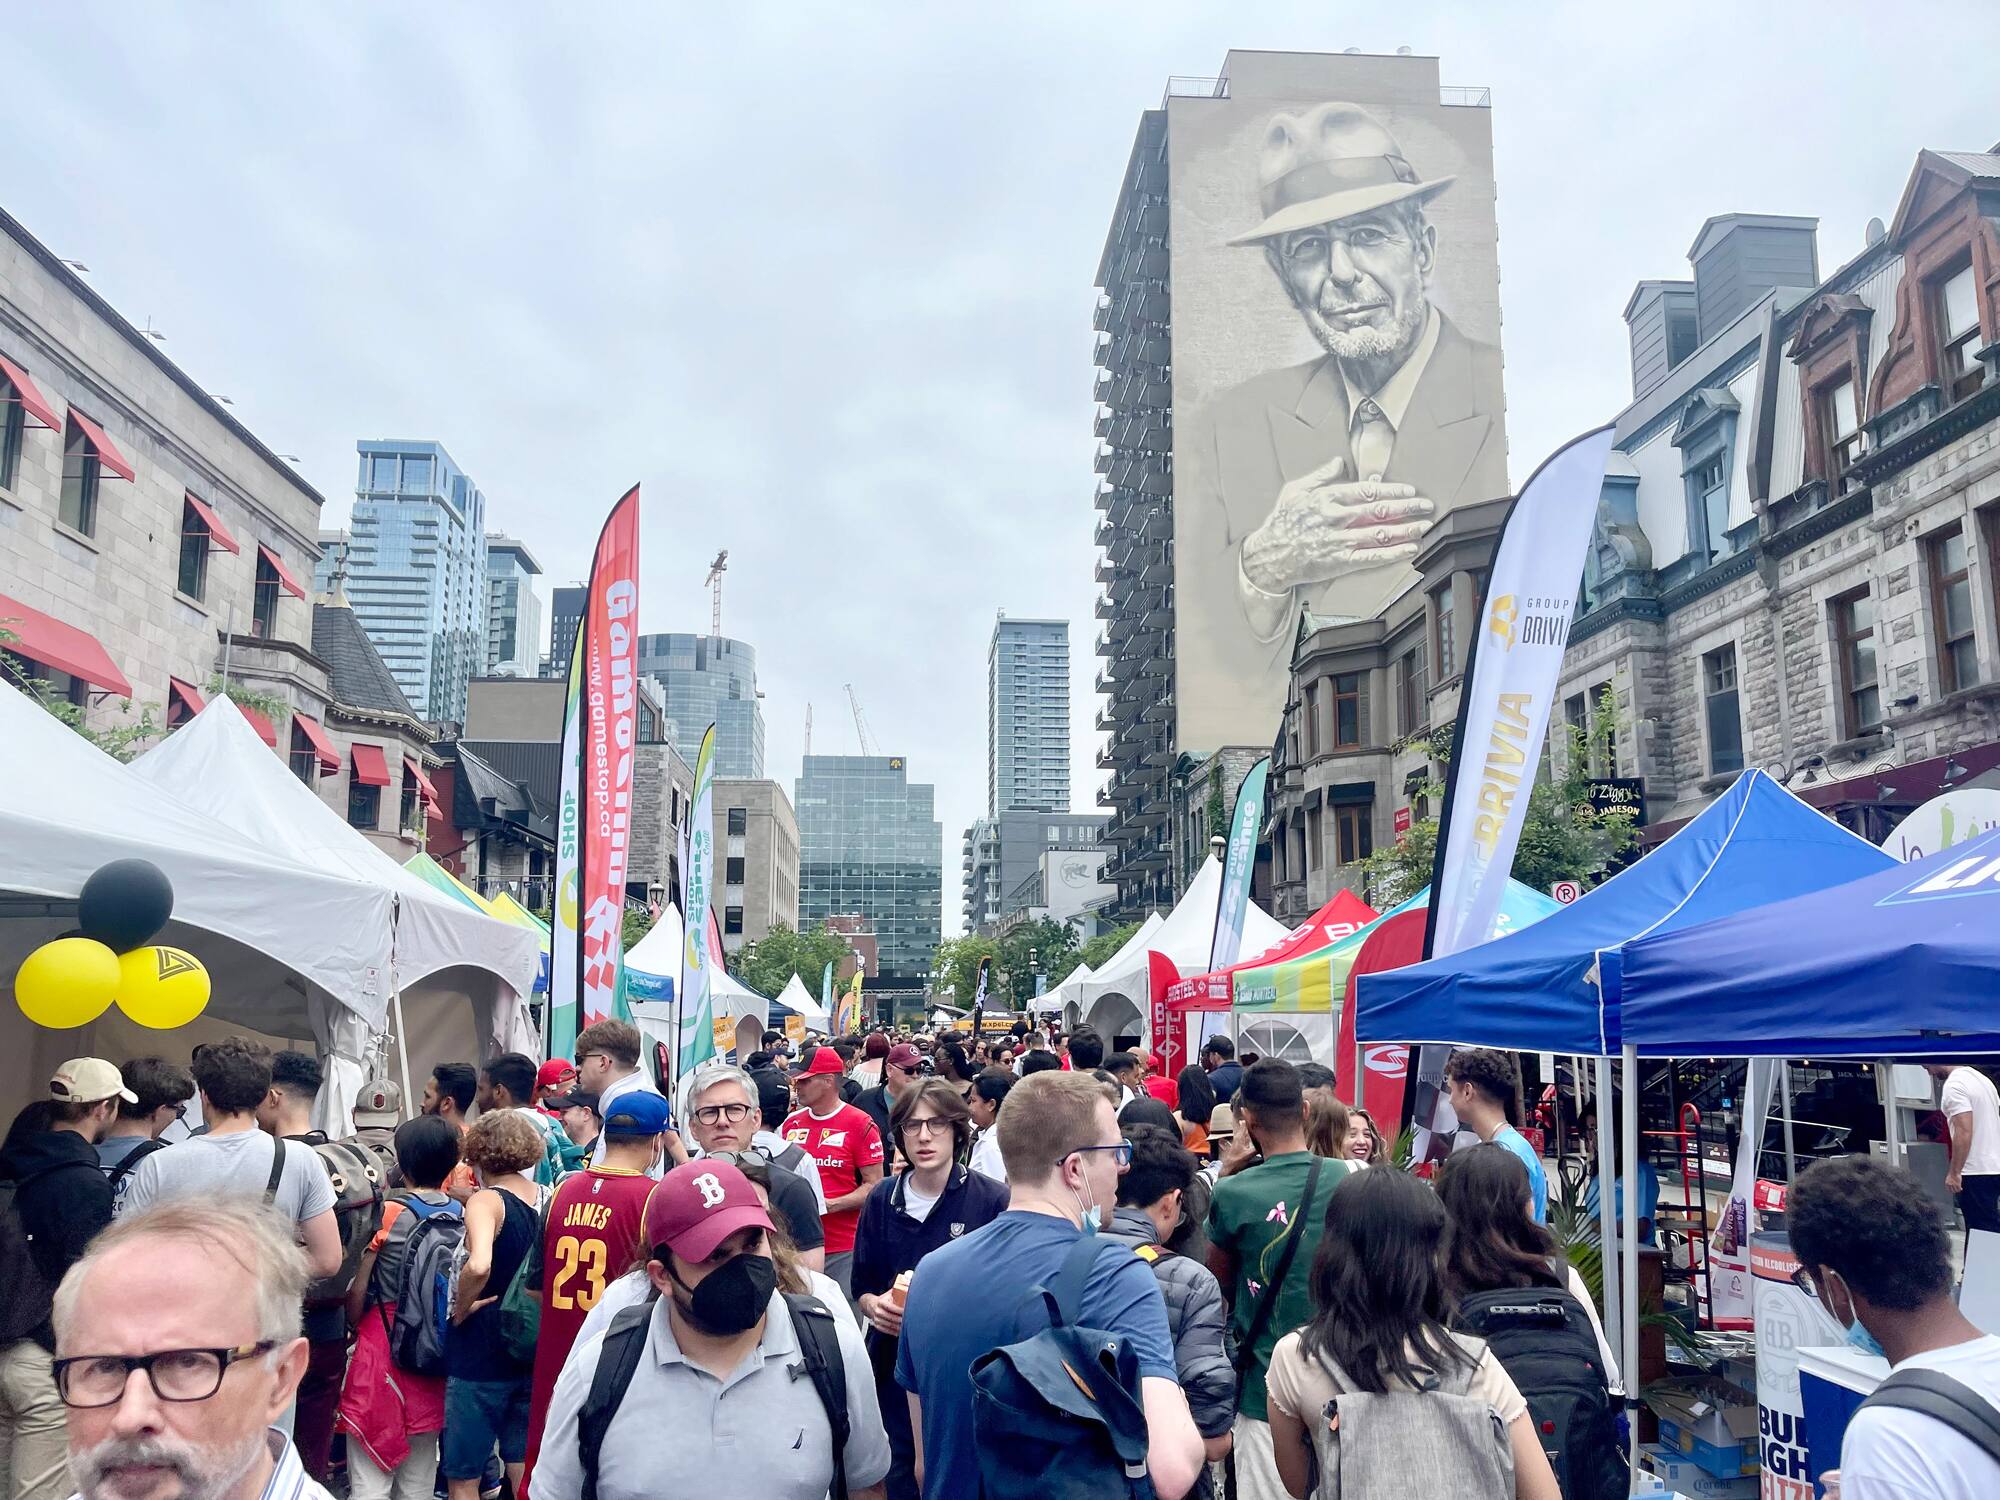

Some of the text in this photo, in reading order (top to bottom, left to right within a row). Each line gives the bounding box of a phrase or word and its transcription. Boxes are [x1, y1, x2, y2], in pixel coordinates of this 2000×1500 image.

[1472, 693, 1532, 848] BRIVIA
[561, 789, 576, 860] SHOP
[1599, 805, 1641, 817] JAMESON
[1907, 854, 2000, 894] LI
[692, 1173, 726, 1209] B
[563, 1202, 612, 1231] JAMES
[551, 1235, 608, 1312] 23
